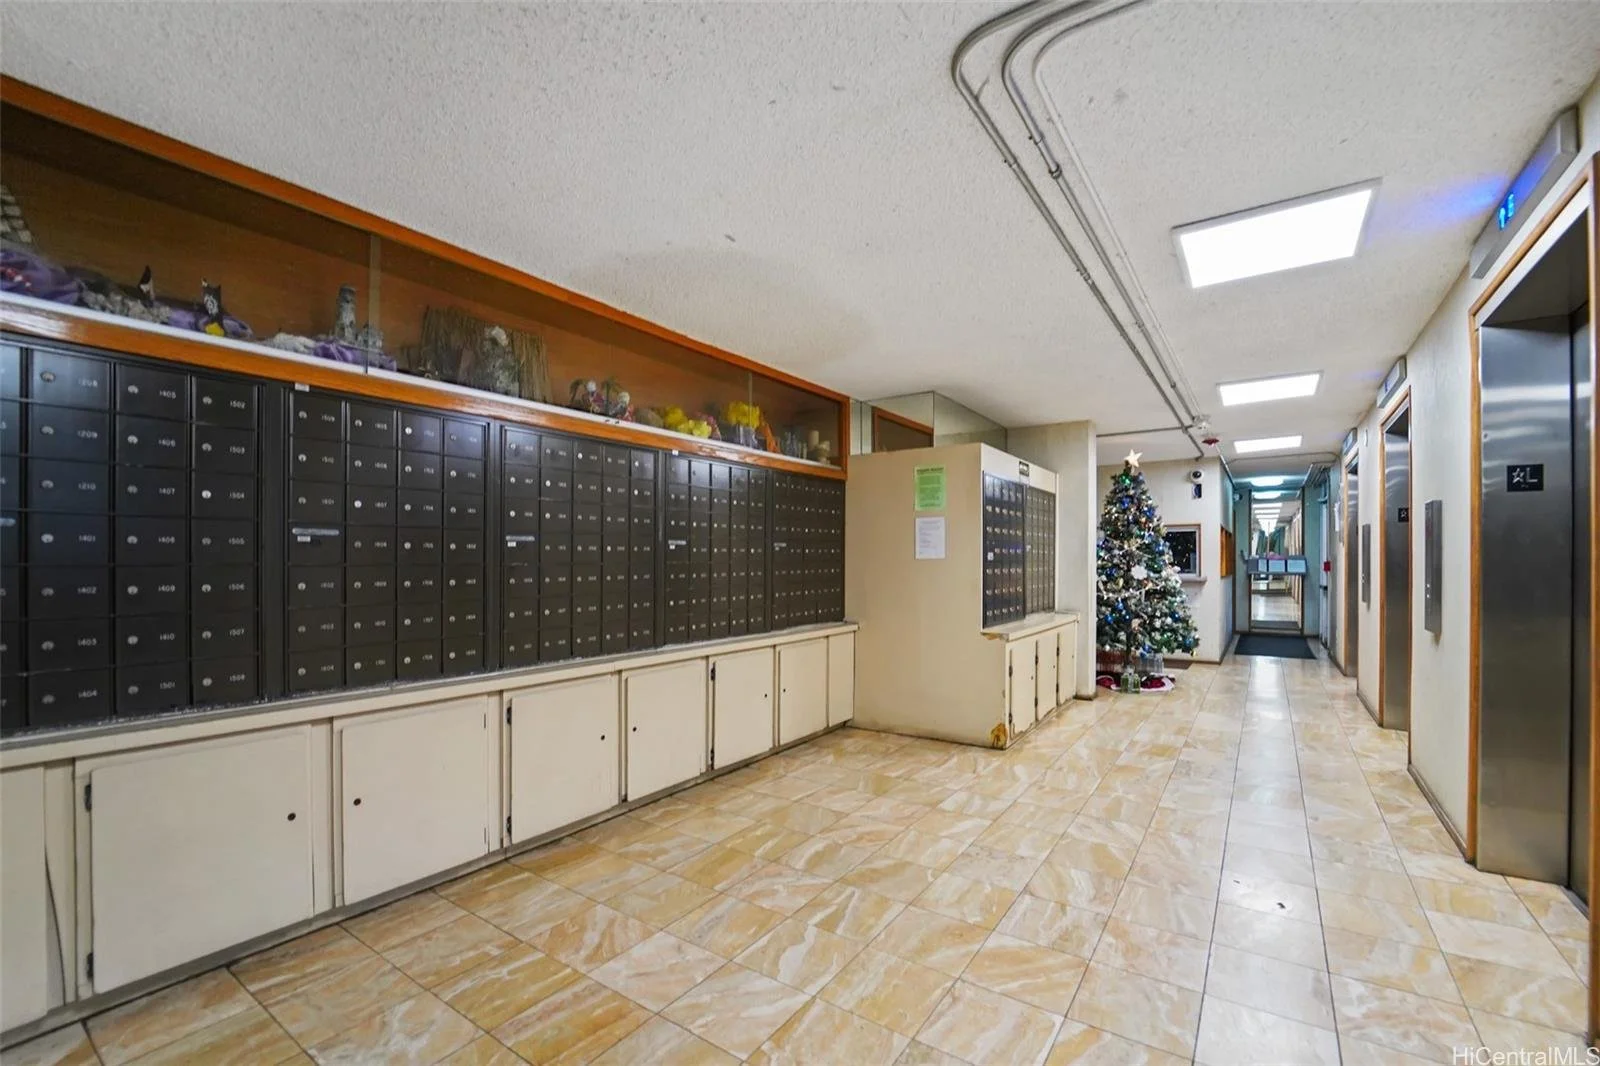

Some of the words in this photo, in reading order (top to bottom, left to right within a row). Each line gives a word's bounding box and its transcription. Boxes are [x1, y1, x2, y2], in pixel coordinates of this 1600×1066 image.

[1526, 467, 1538, 483] L
[159, 487, 176, 495] 1407
[158, 584, 176, 593] 1409
[77, 637, 97, 646] 1403
[78, 689, 98, 698] 1404
